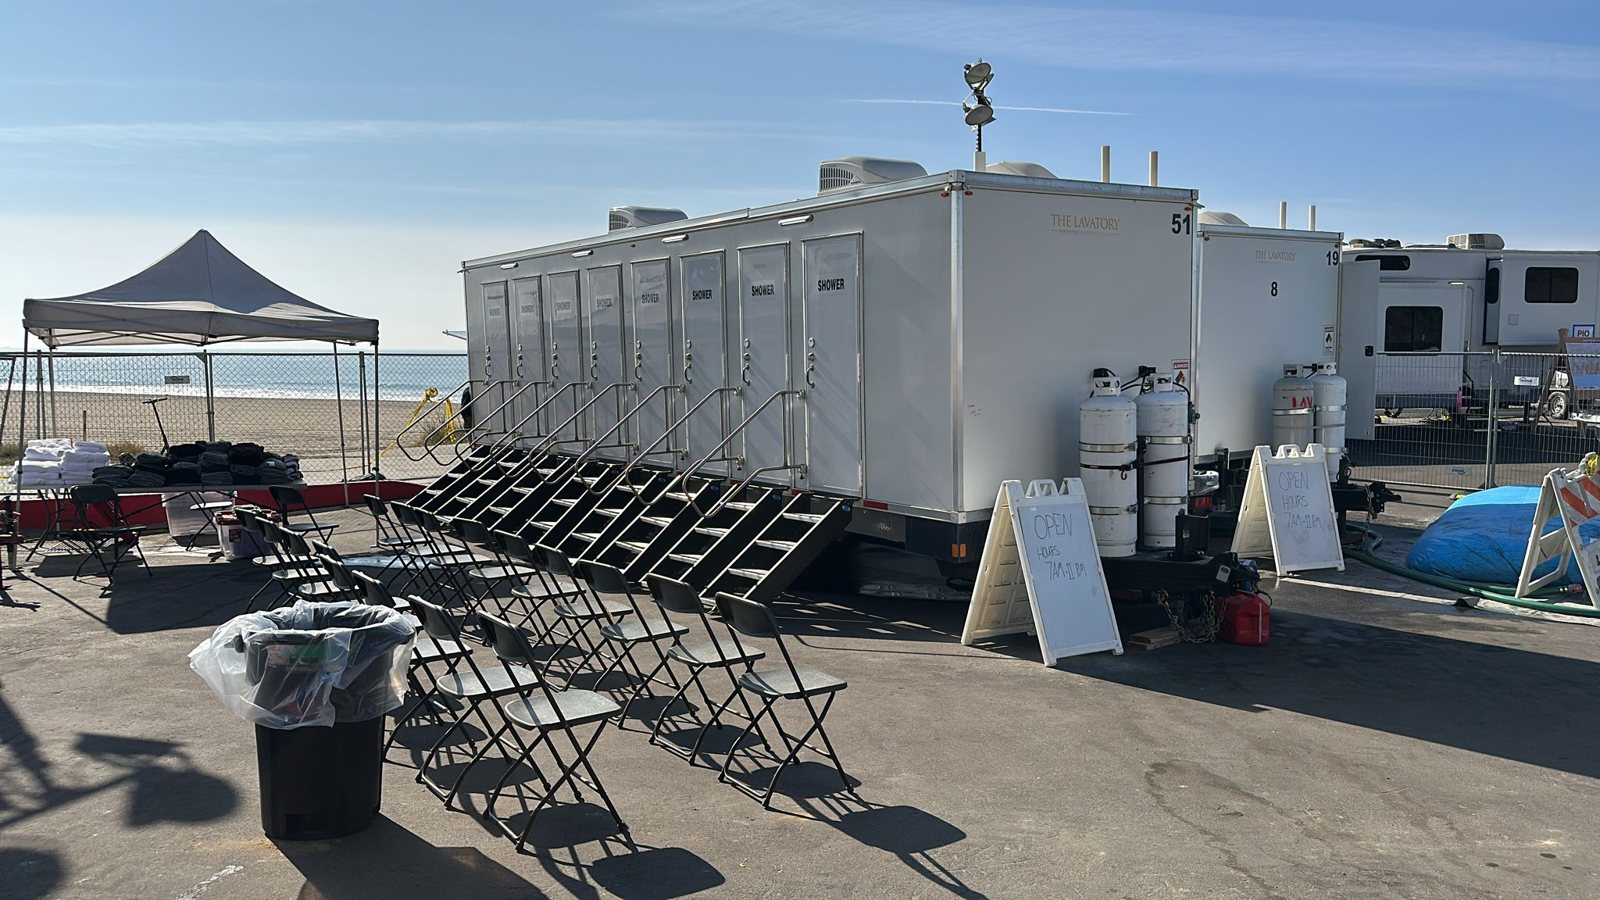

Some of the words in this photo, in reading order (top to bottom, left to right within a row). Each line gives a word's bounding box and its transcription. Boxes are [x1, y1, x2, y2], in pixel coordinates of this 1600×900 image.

[1050, 214, 1071, 227] THE
[1074, 216, 1120, 230] LAVATORY
[1171, 213, 1190, 235] 51
[1255, 250, 1267, 260] THE
[1268, 251, 1297, 261] LAVATORY
[1326, 251, 1339, 266] 19
[751, 284, 775, 297] SHOWER
[817, 278, 845, 292] SHOWER
[1270, 281, 1278, 297] 8
[641, 293, 660, 304] SHOWER
[692, 289, 713, 301] SHOWER
[1577, 329, 1590, 337] PIO
[1278, 470, 1309, 491] OPEN
[1282, 495, 1309, 510] HOURS
[1034, 512, 1073, 539] OPEN
[1037, 545, 1061, 560] HOURS
